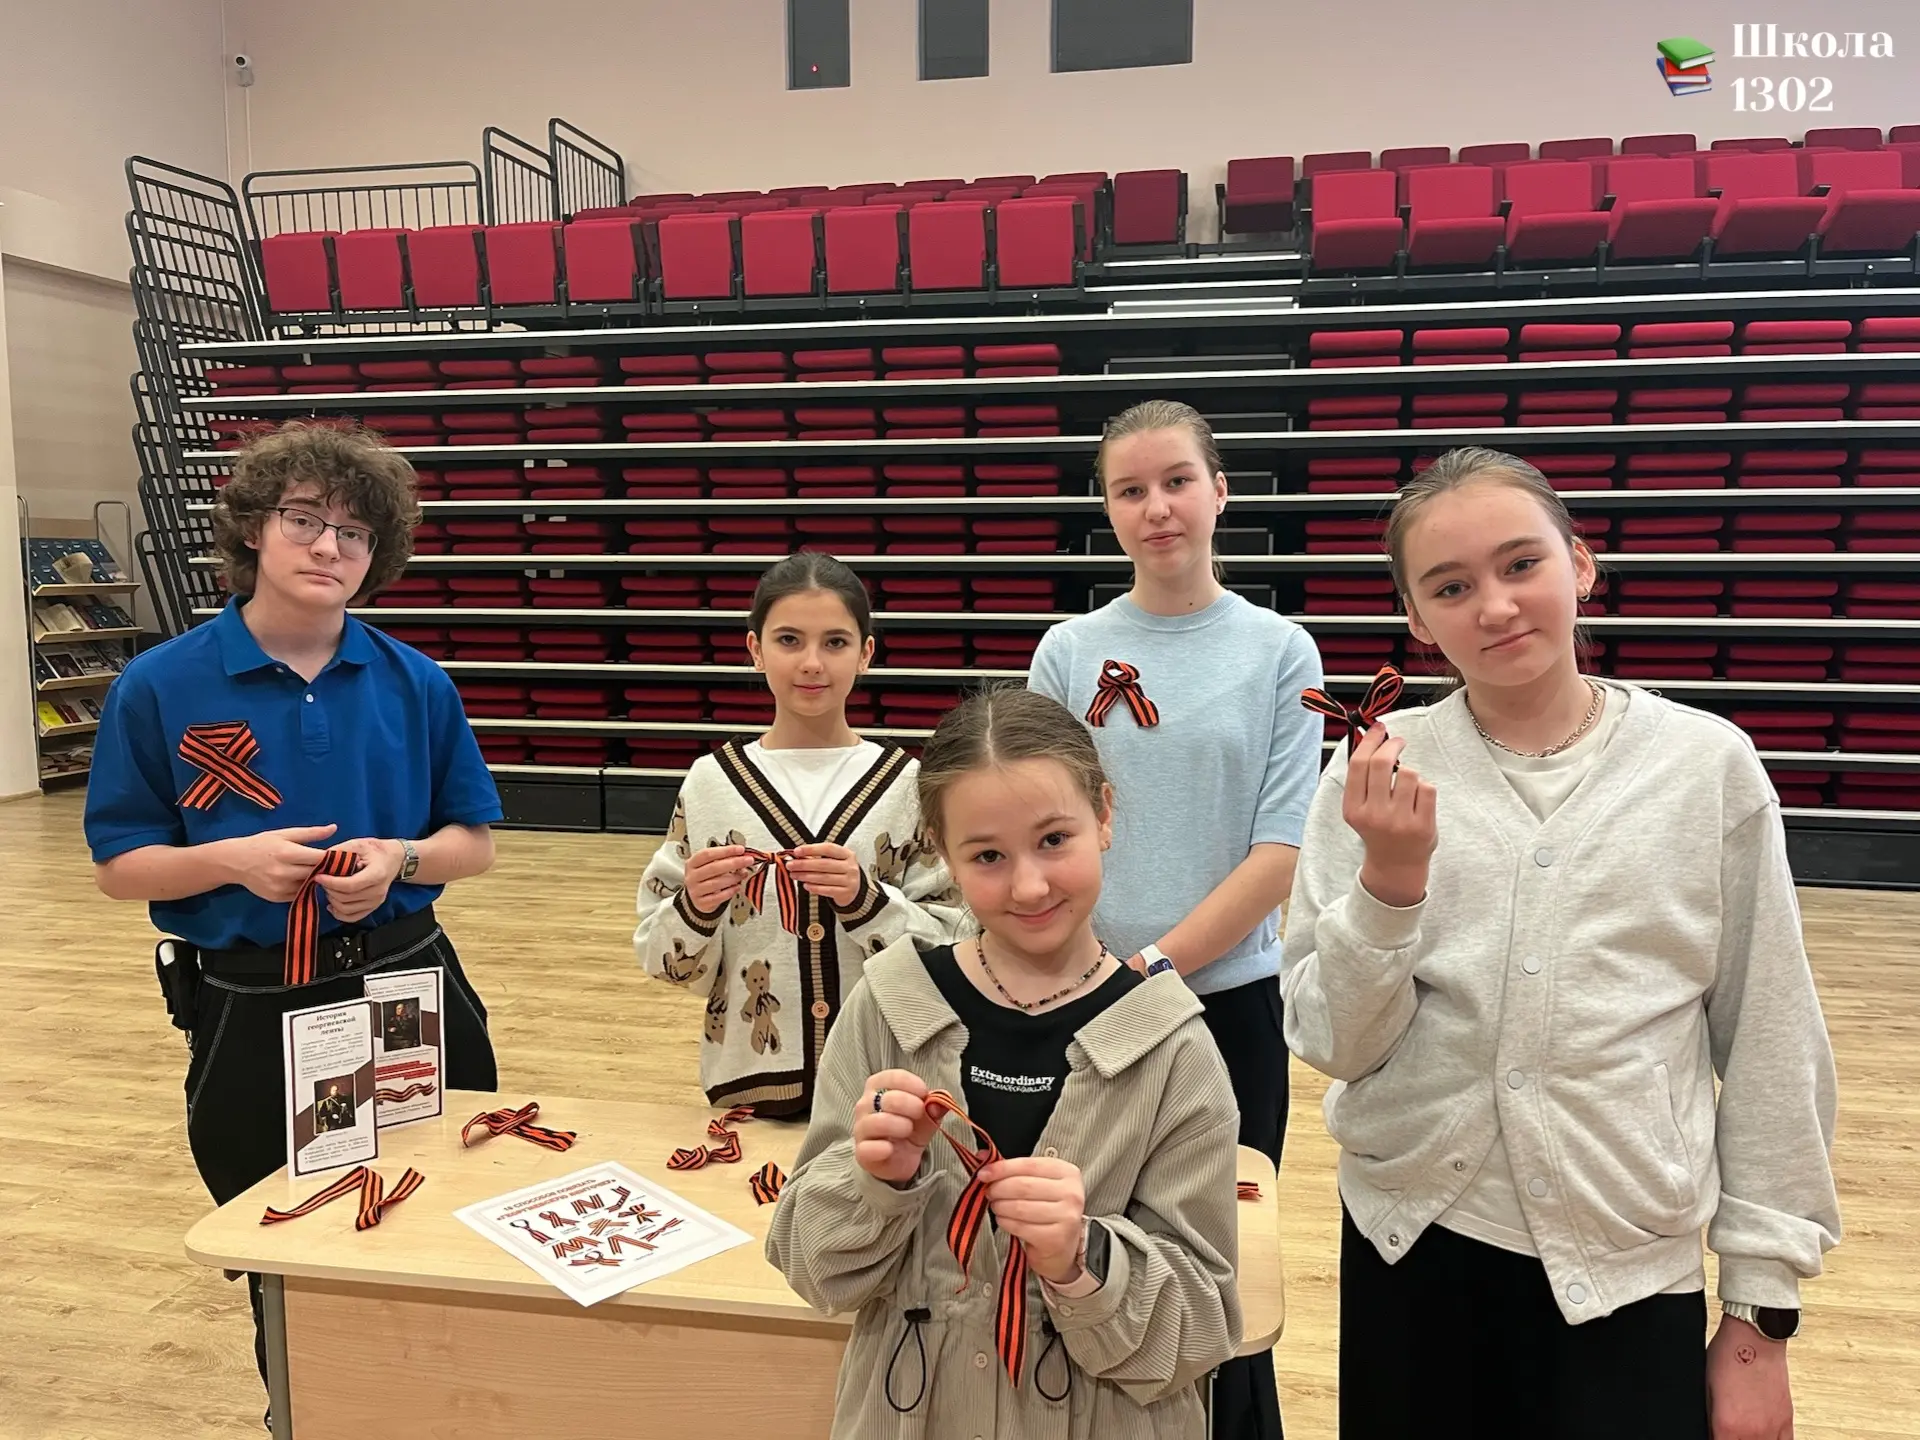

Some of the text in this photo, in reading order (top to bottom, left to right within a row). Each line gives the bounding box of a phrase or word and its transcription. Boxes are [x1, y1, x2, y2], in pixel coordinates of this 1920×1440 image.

[316, 1011, 347, 1021] История
[307, 1015, 356, 1031] георгиевской
[320, 1026, 345, 1036] ленты
[970, 1065, 1055, 1087] Extraordinary
